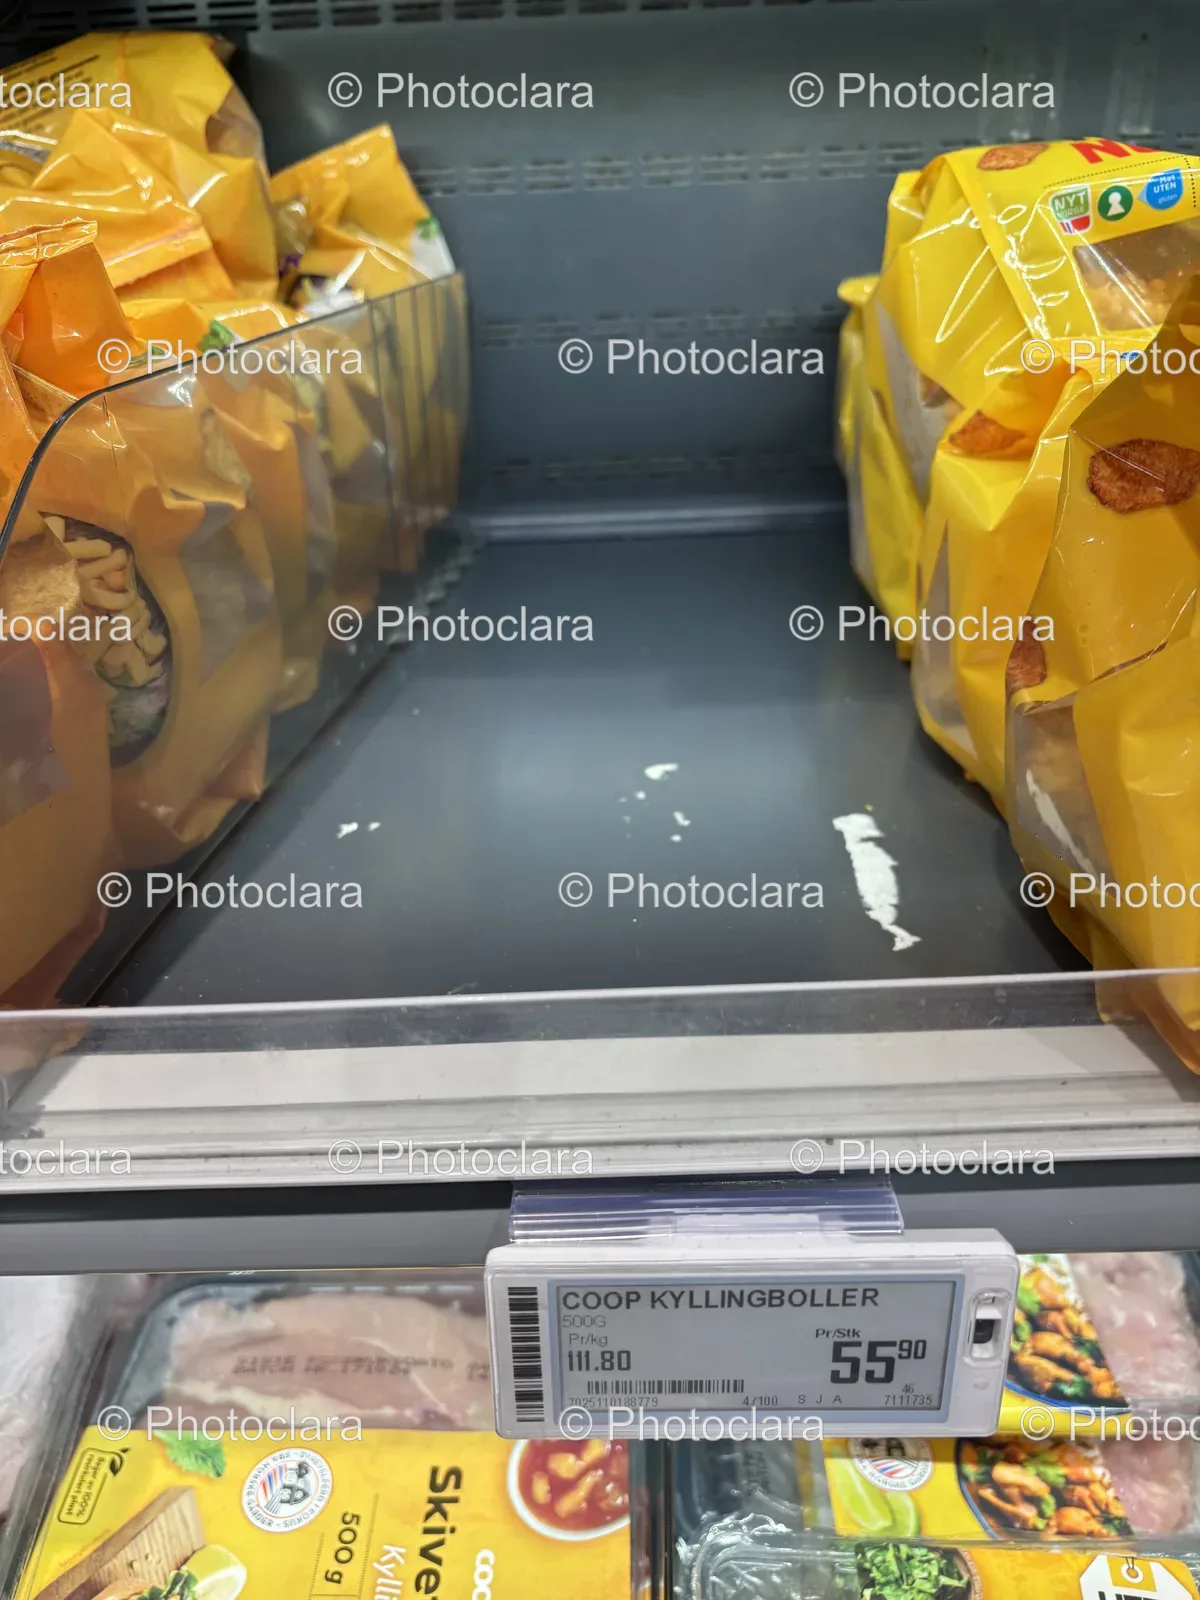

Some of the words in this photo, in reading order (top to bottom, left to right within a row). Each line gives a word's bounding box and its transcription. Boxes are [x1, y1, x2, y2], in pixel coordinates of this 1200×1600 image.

[1153, 181, 1177, 193] UTEN
[1054, 190, 1087, 211] NYT
[562, 1291, 641, 1310] COOP
[650, 1288, 879, 1309] KYLLINGBOLLER
[561, 1314, 606, 1328] 500G
[568, 1333, 608, 1347] Pr/kg
[815, 1328, 861, 1338] Pr/Stk
[568, 1350, 631, 1371] 111.80
[798, 1394, 806, 1404] S
[815, 1394, 823, 1404] J
[832, 1394, 842, 1404] A
[884, 1394, 933, 1406] 7111735
[76, 1491, 92, 1517] 100%
[334, 1511, 361, 1565] 500
[414, 1465, 463, 1600] Skive
[324, 1568, 343, 1585] g
